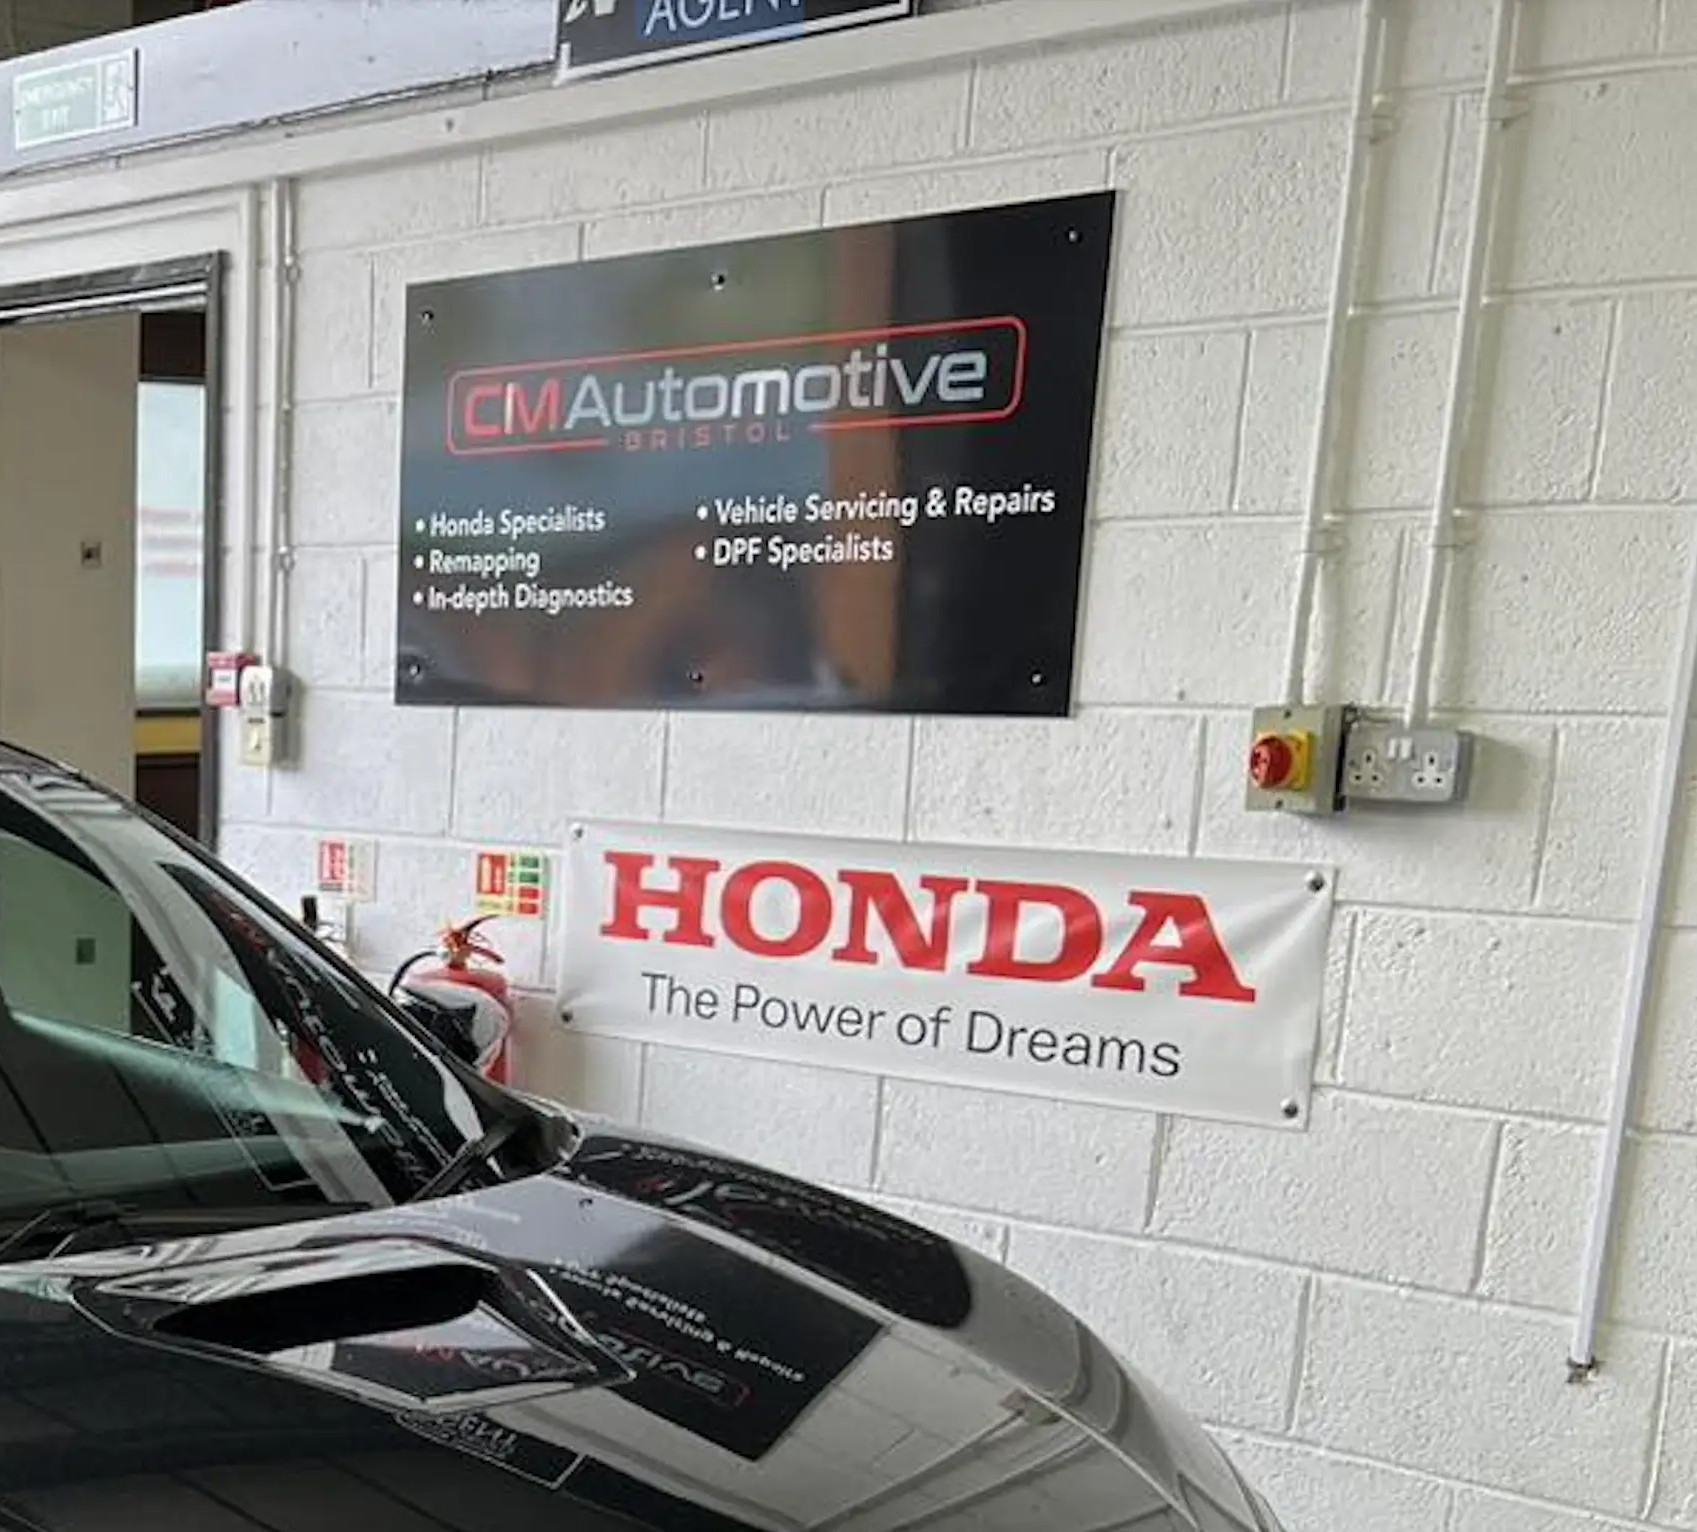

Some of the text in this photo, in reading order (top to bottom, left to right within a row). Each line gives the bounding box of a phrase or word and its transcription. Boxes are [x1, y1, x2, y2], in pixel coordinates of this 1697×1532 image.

[463, 344, 988, 437] CMAutomotive
[624, 422, 792, 451] BRISTOL
[430, 503, 606, 541] Honda Specialists
[714, 484, 1056, 527] Vehicle Servicing & Repairs
[429, 547, 541, 579] Remapping
[713, 533, 894, 571] DPF Specialists
[428, 581, 634, 616] In-depth Diagnostics
[600, 850, 1257, 1003] HONDA
[641, 972, 1183, 1079] The Power of Dreams
